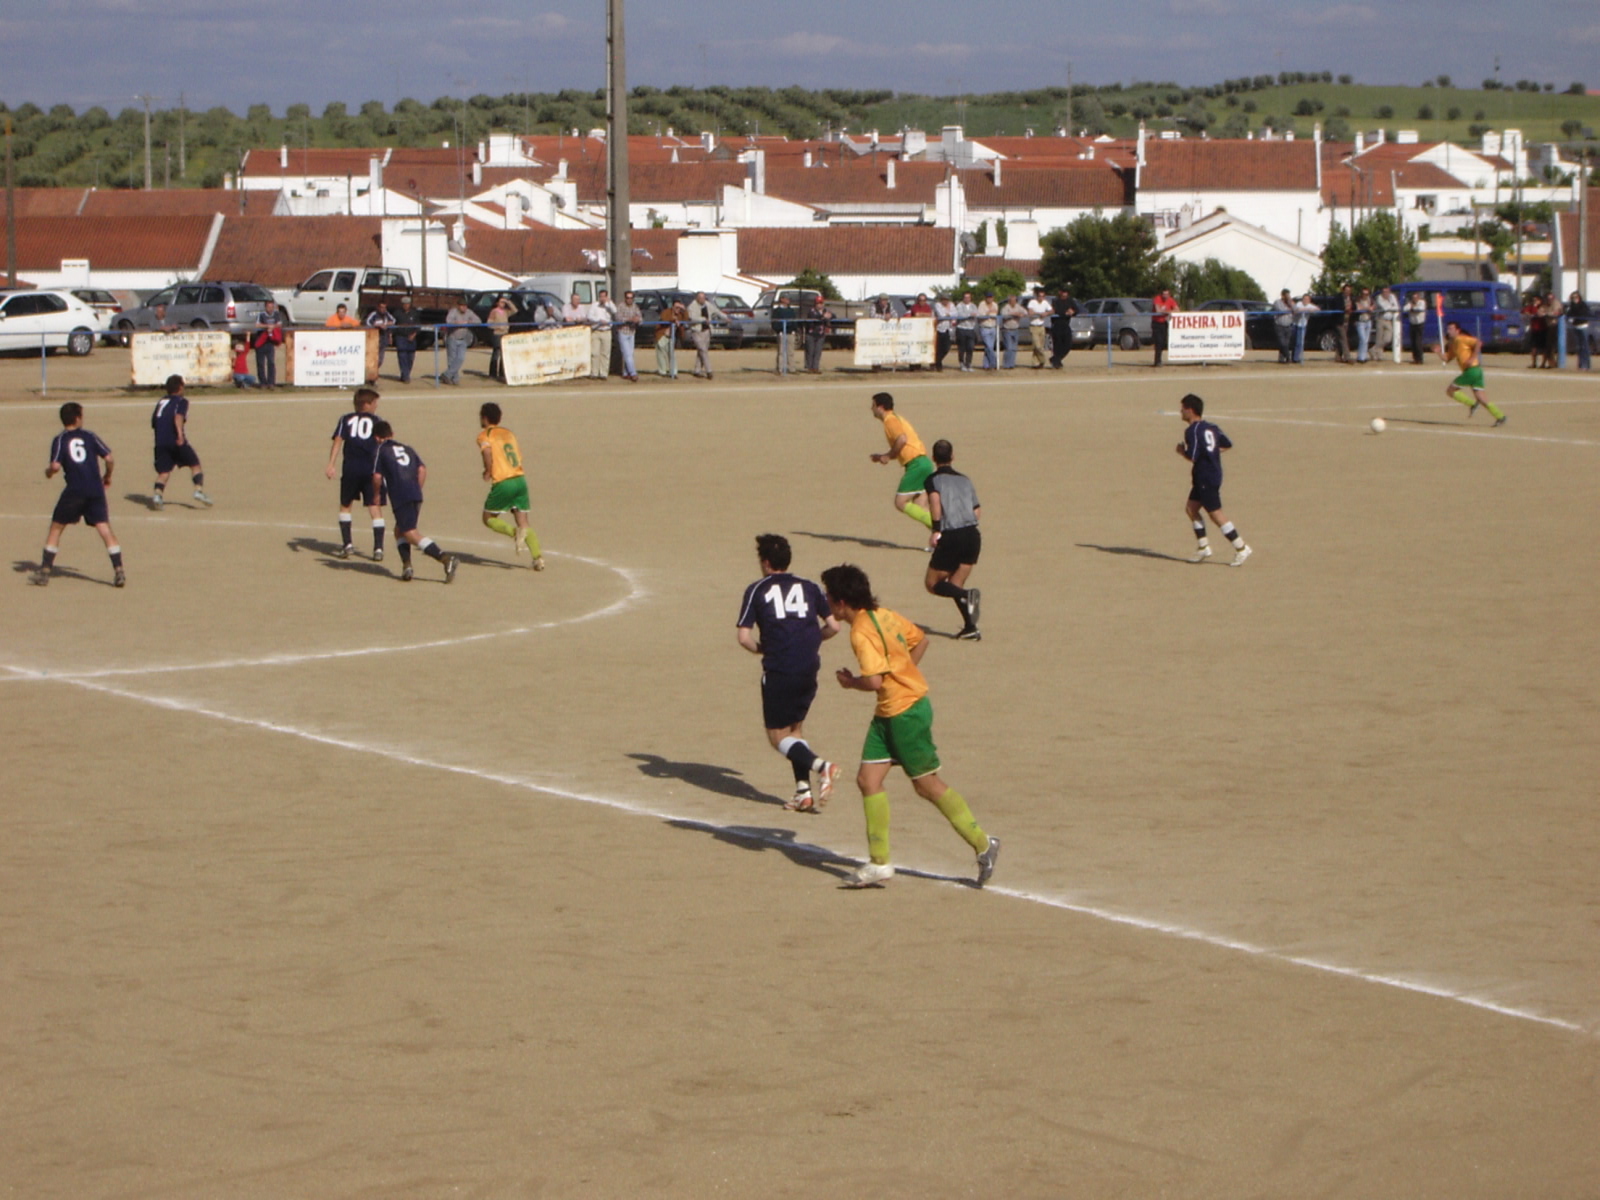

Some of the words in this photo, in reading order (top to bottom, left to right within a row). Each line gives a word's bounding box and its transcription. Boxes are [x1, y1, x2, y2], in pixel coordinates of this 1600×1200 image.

[1171, 315, 1218, 330] TEIXEIRA,
[1222, 315, 1242, 328] LDA
[157, 399, 171, 418] 7
[348, 415, 373, 440] 10
[69, 438, 87, 463] 6
[1204, 429, 1216, 452] 9
[392, 445, 410, 467] 5
[503, 443, 519, 468] 6
[764, 582, 809, 620] 14
